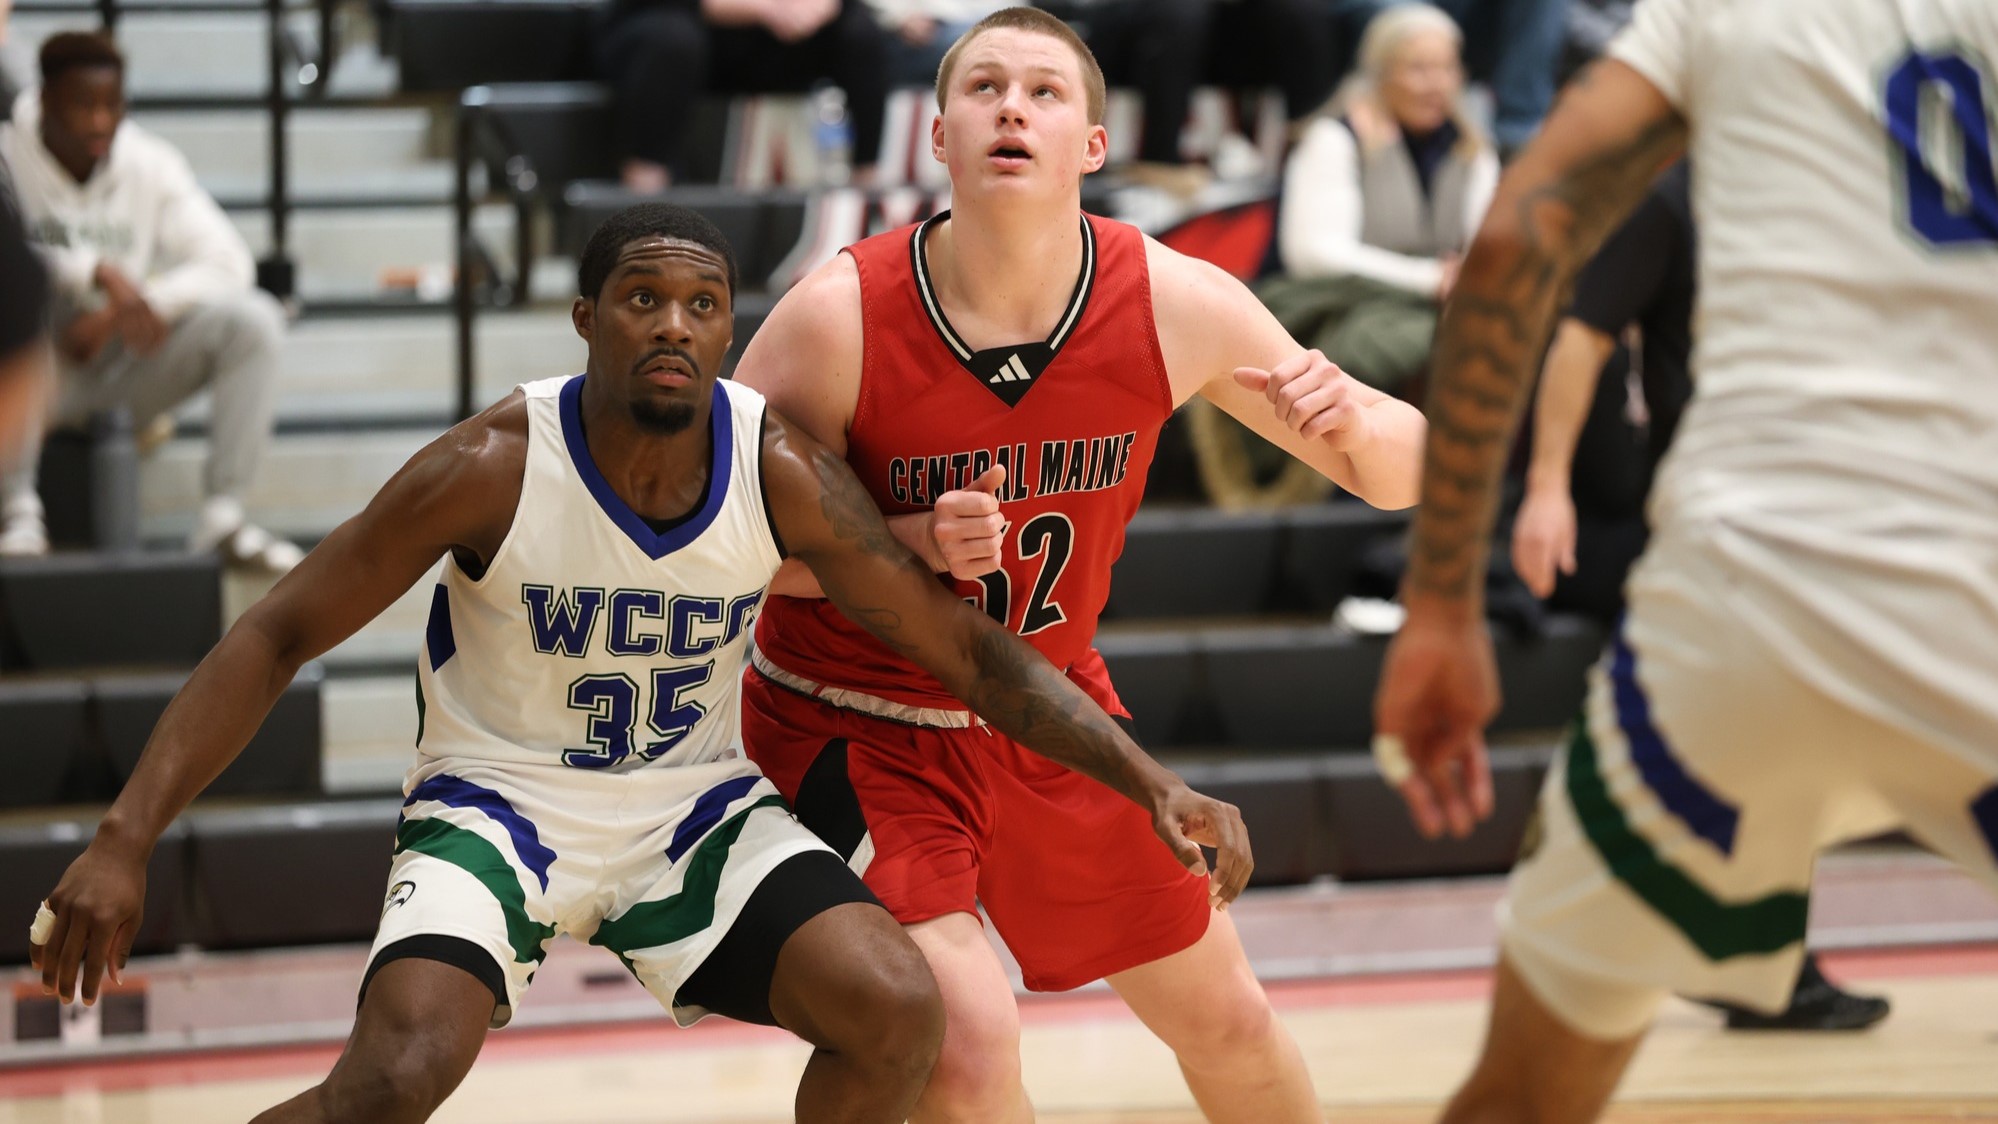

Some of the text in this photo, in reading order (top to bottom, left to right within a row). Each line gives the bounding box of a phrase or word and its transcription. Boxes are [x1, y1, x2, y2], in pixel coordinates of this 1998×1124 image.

[1869, 37, 1998, 256] 0
[1034, 431, 1137, 498] MAINE
[560, 657, 716, 768] 35
